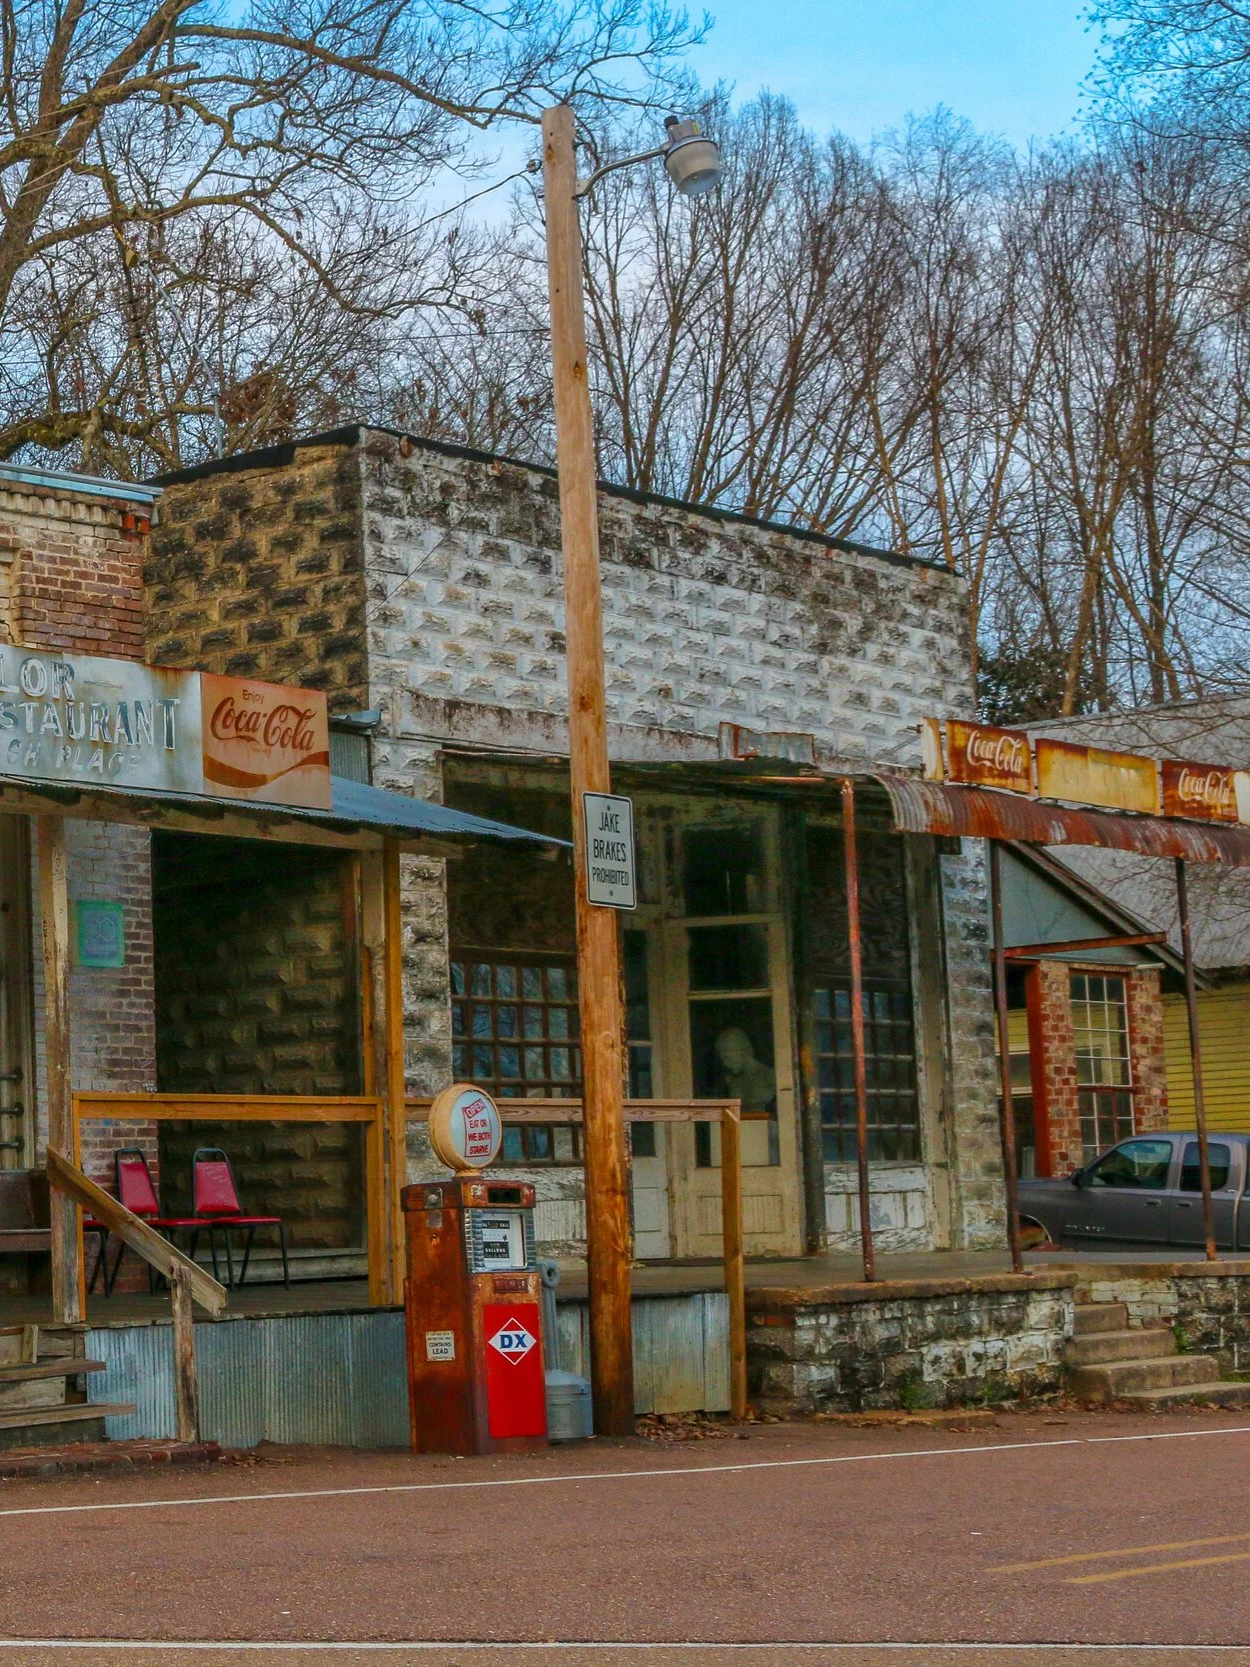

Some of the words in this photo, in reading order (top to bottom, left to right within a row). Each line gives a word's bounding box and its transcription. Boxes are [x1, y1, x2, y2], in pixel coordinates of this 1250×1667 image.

[242, 689, 265, 704] Enjoy
[211, 696, 317, 751] Coca-Cola
[56, 745, 142, 777] PLACE
[598, 811, 620, 833] JAKE
[593, 839, 627, 862] BRAKES
[592, 867, 629, 886] PROHIBITED
[465, 1099, 486, 1117] OPEN
[469, 1120, 480, 1128] EAT
[468, 1132, 478, 1141] WE
[469, 1145, 489, 1154] STARVE
[499, 1333, 528, 1349] DX
[432, 1347, 449, 1355] LEAD
